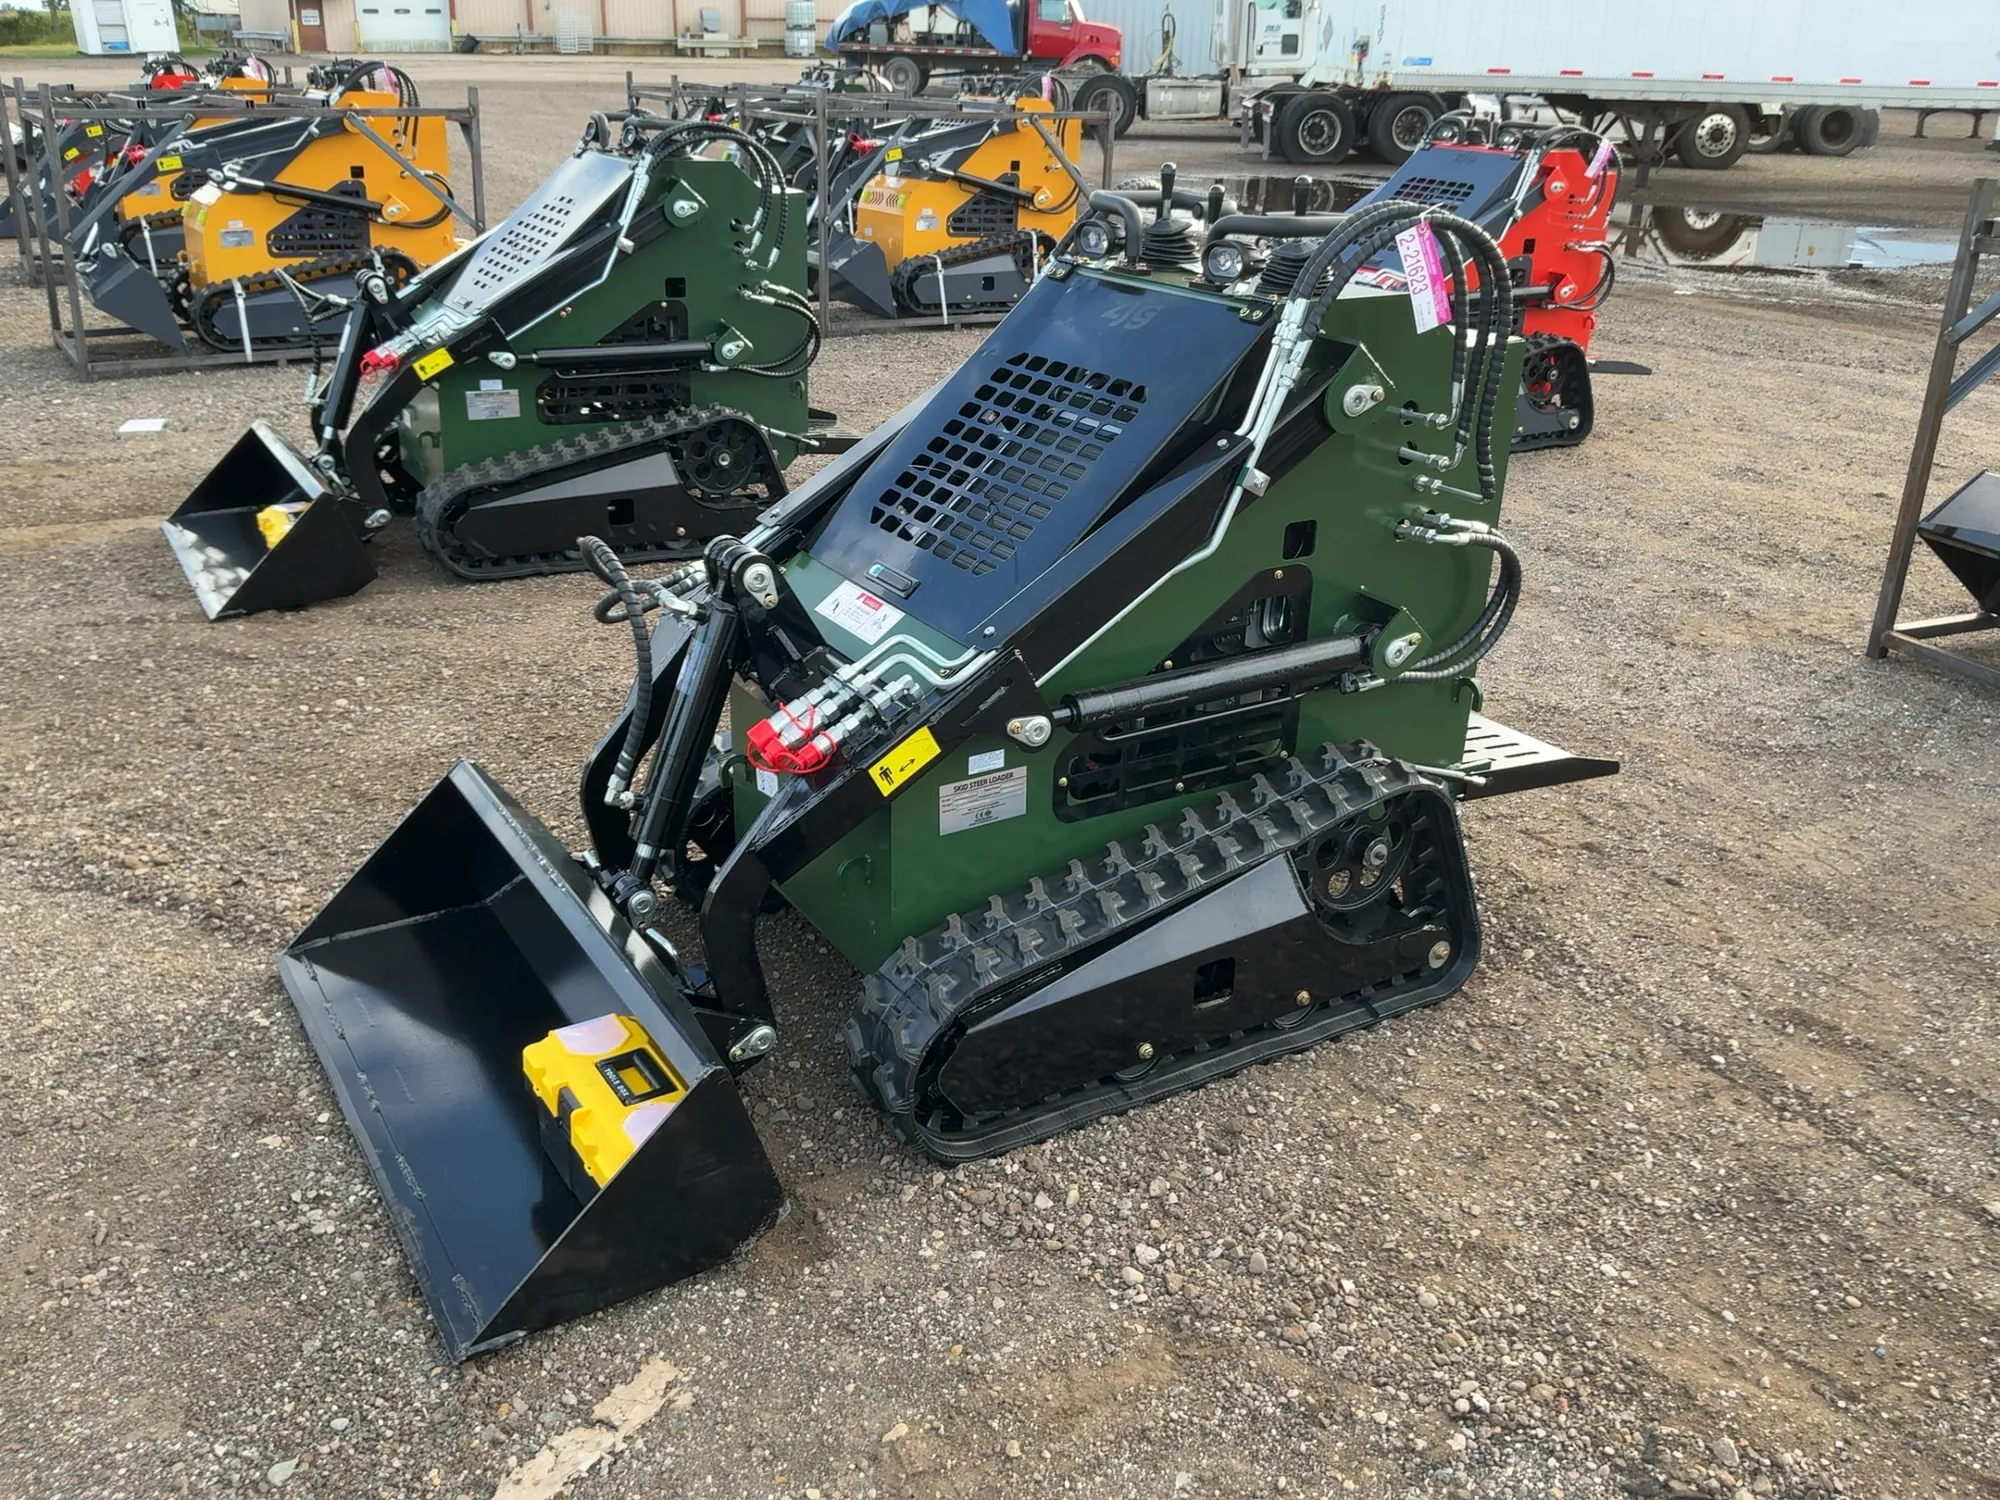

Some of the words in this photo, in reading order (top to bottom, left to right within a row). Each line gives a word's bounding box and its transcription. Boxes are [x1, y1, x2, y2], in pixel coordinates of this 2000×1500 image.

[1399, 234, 1429, 295] 2-21623
[953, 783, 969, 793] SKID
[969, 778, 988, 790] STEER
[988, 771, 1014, 784] LOADER
[604, 1067, 620, 1085] TOOLS
[617, 1085, 630, 1097] BOX
